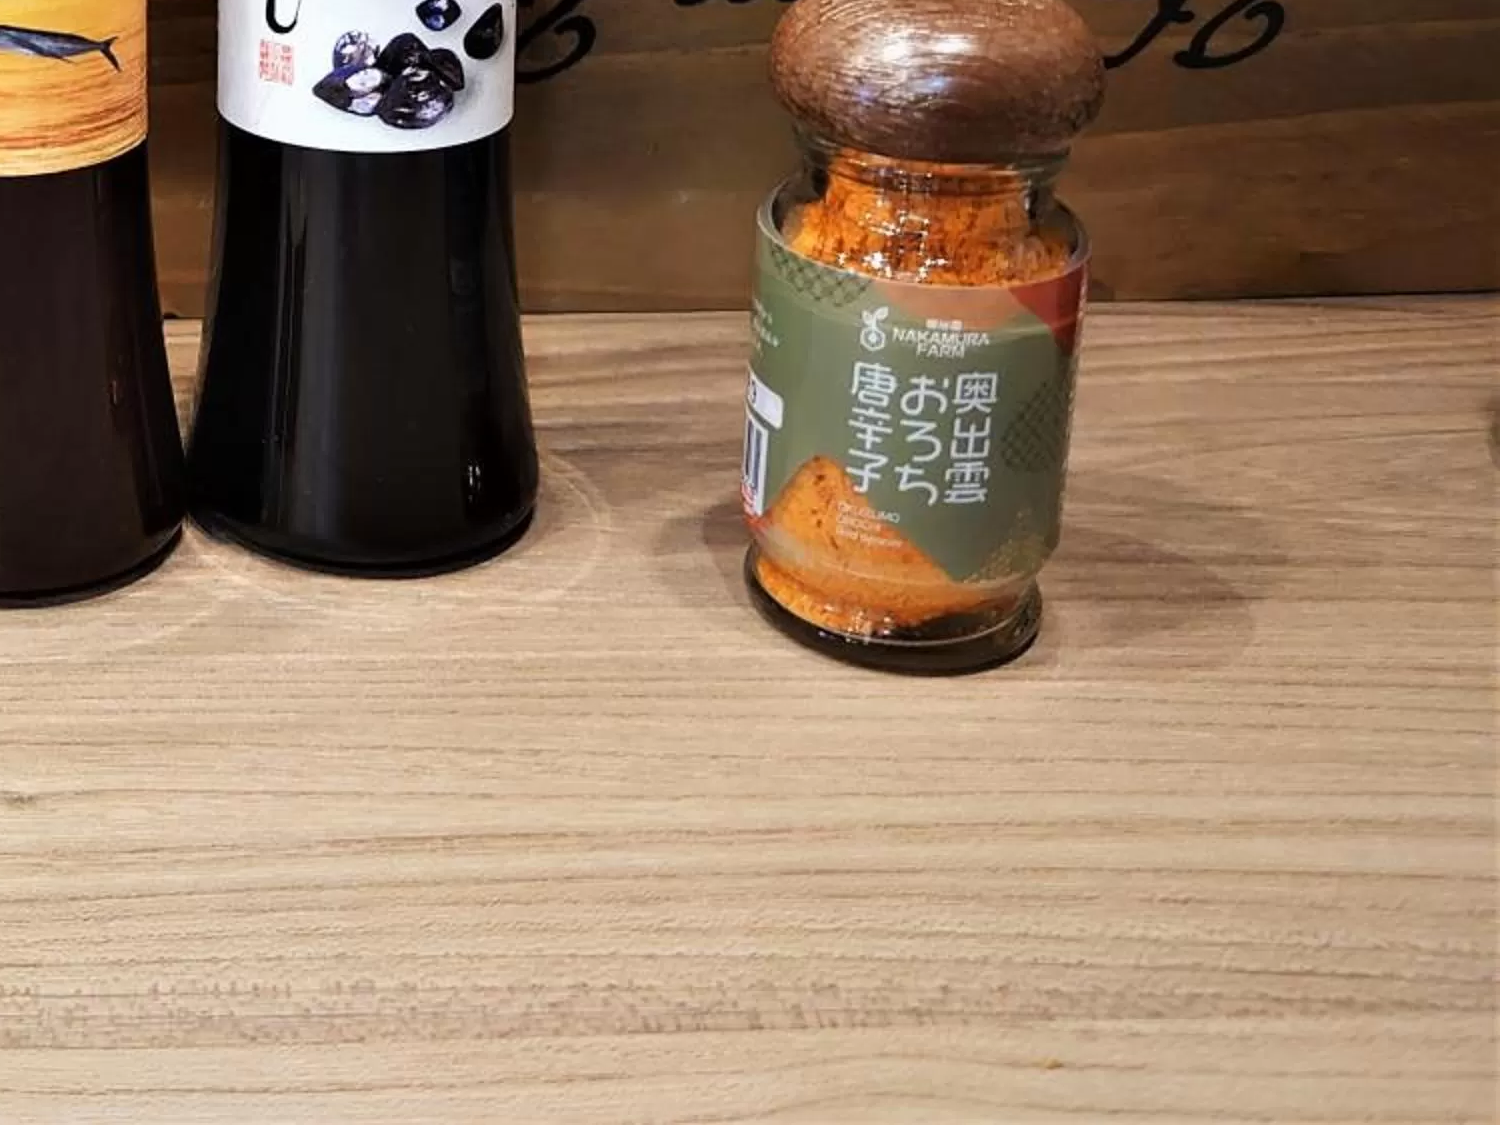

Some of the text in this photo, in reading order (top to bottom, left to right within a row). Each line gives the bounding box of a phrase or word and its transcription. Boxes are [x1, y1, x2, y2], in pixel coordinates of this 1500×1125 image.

[891, 326, 991, 348] NAKAMURA
[915, 341, 966, 360] FARM
[898, 375, 949, 507] おろち
[943, 371, 999, 505] 奥出雲
